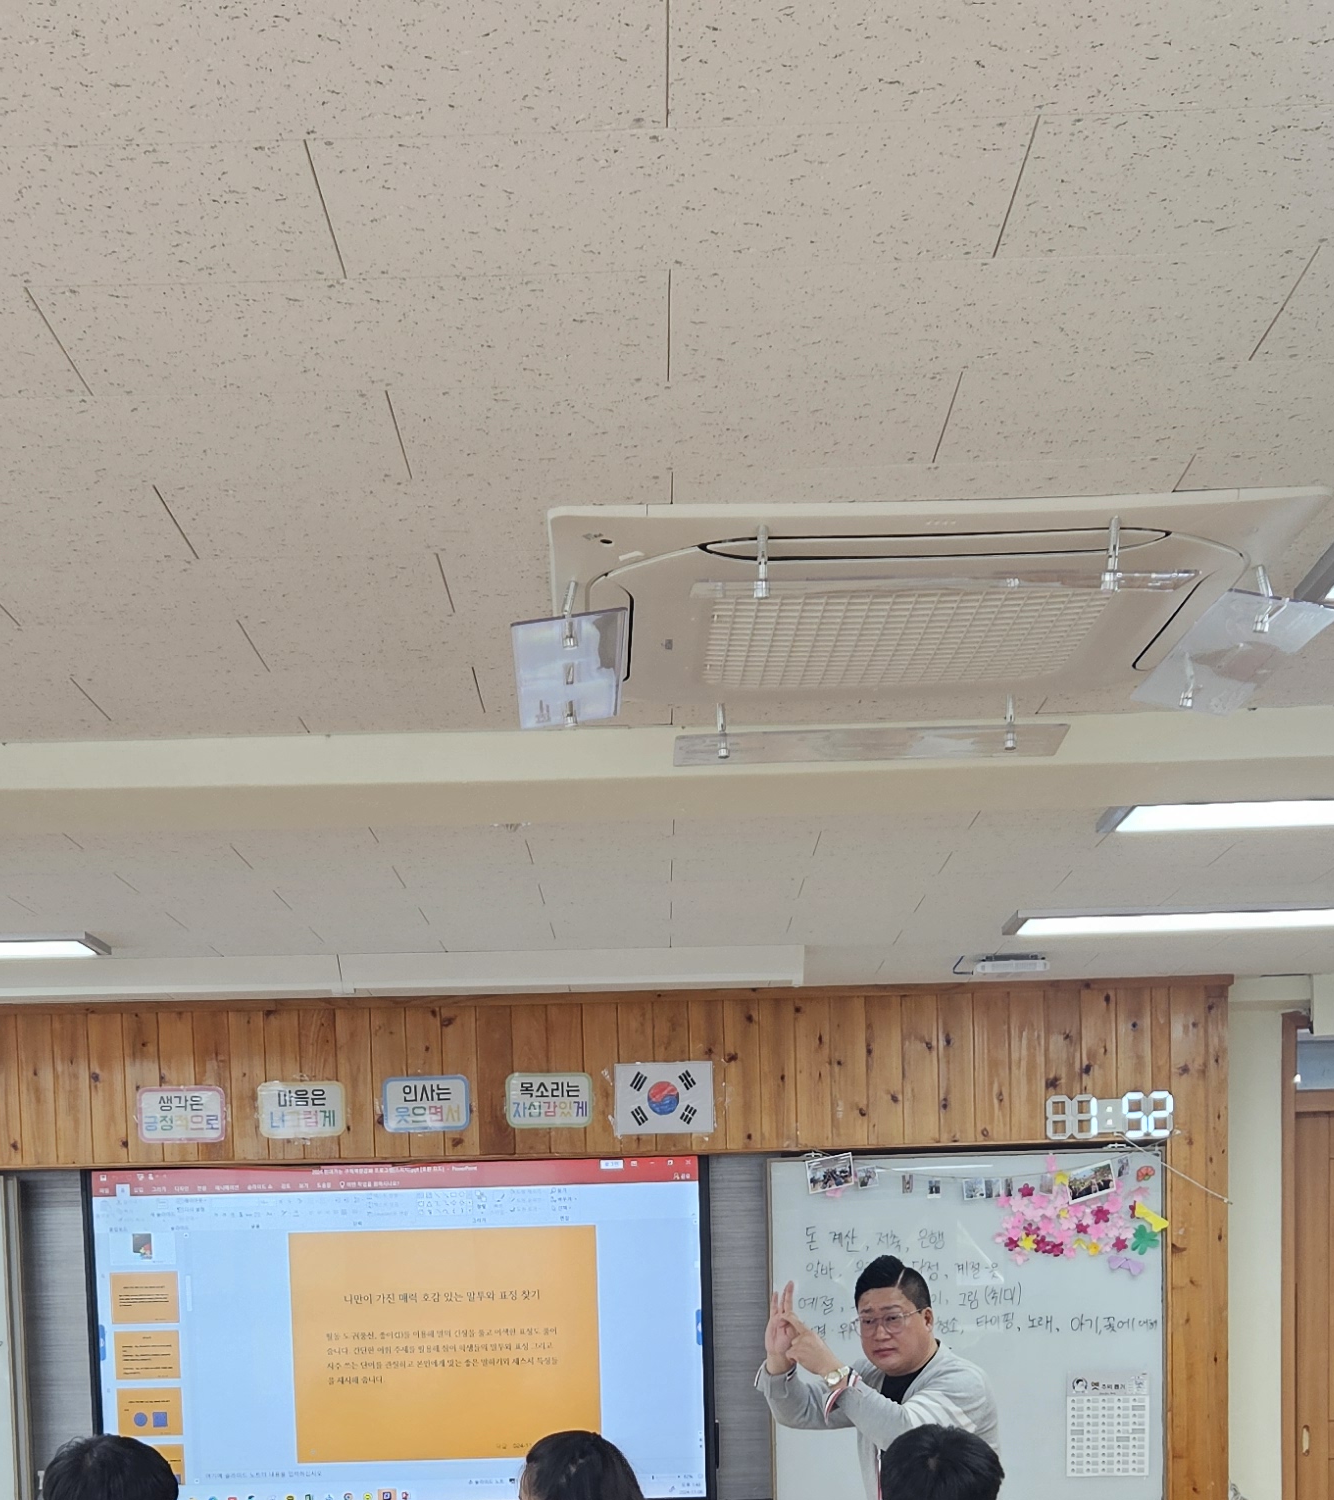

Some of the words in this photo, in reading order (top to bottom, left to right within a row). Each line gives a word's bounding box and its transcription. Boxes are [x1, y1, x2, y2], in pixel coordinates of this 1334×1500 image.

[277, 1088, 327, 1107] 마음은
[402, 1083, 452, 1102] 인사는
[520, 1081, 581, 1099] 목소리는
[158, 1095, 204, 1112] 생각은
[512, 1100, 588, 1118] 자신감있게
[144, 1114, 220, 1132] 긍정적으로
[269, 1109, 336, 1129] 너그럽게
[395, 1104, 461, 1124] 웃으면서
[805, 1225, 819, 1251] 돈
[917, 1227, 946, 1250] 은행
[375, 1292, 395, 1304] 가진
[421, 1291, 441, 1303] 호감
[443, 1291, 463, 1303] 있는
[498, 1289, 518, 1301] 표정
[521, 1288, 541, 1301] 찾기
[958, 1290, 979, 1310] 그림
